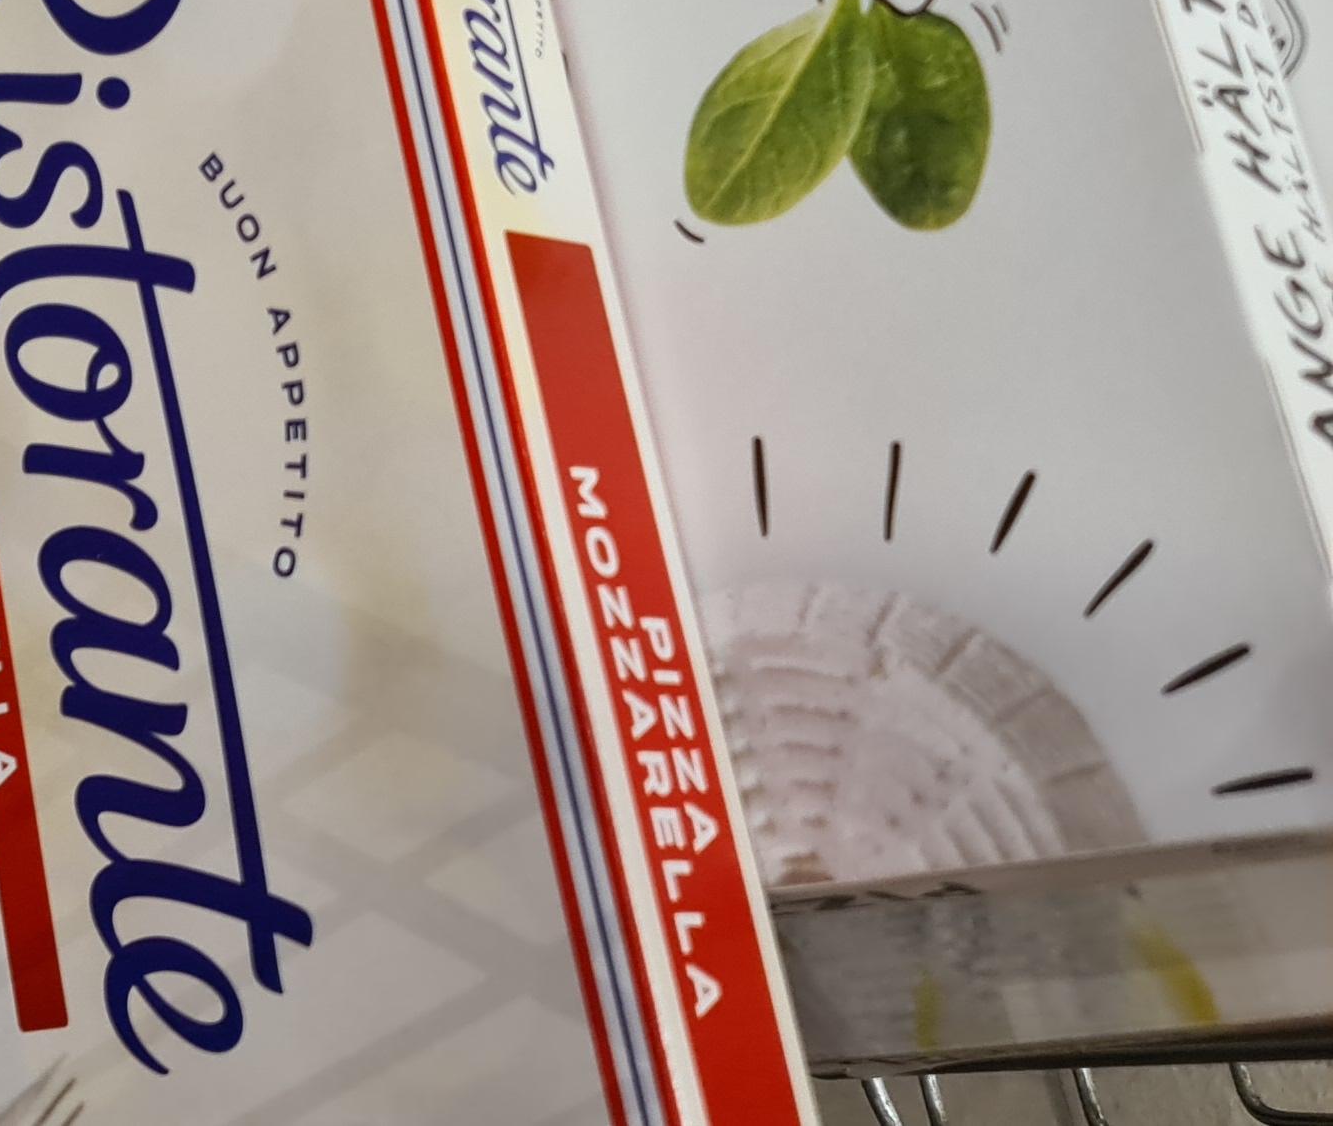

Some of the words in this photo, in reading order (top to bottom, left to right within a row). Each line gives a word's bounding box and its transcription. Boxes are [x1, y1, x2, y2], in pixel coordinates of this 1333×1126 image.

[199, 151, 278, 281] BUON
[266, 306, 309, 579] APPETITO
[567, 462, 725, 1020] MOZZARELLA
[640, 614, 720, 855] PIZZA
